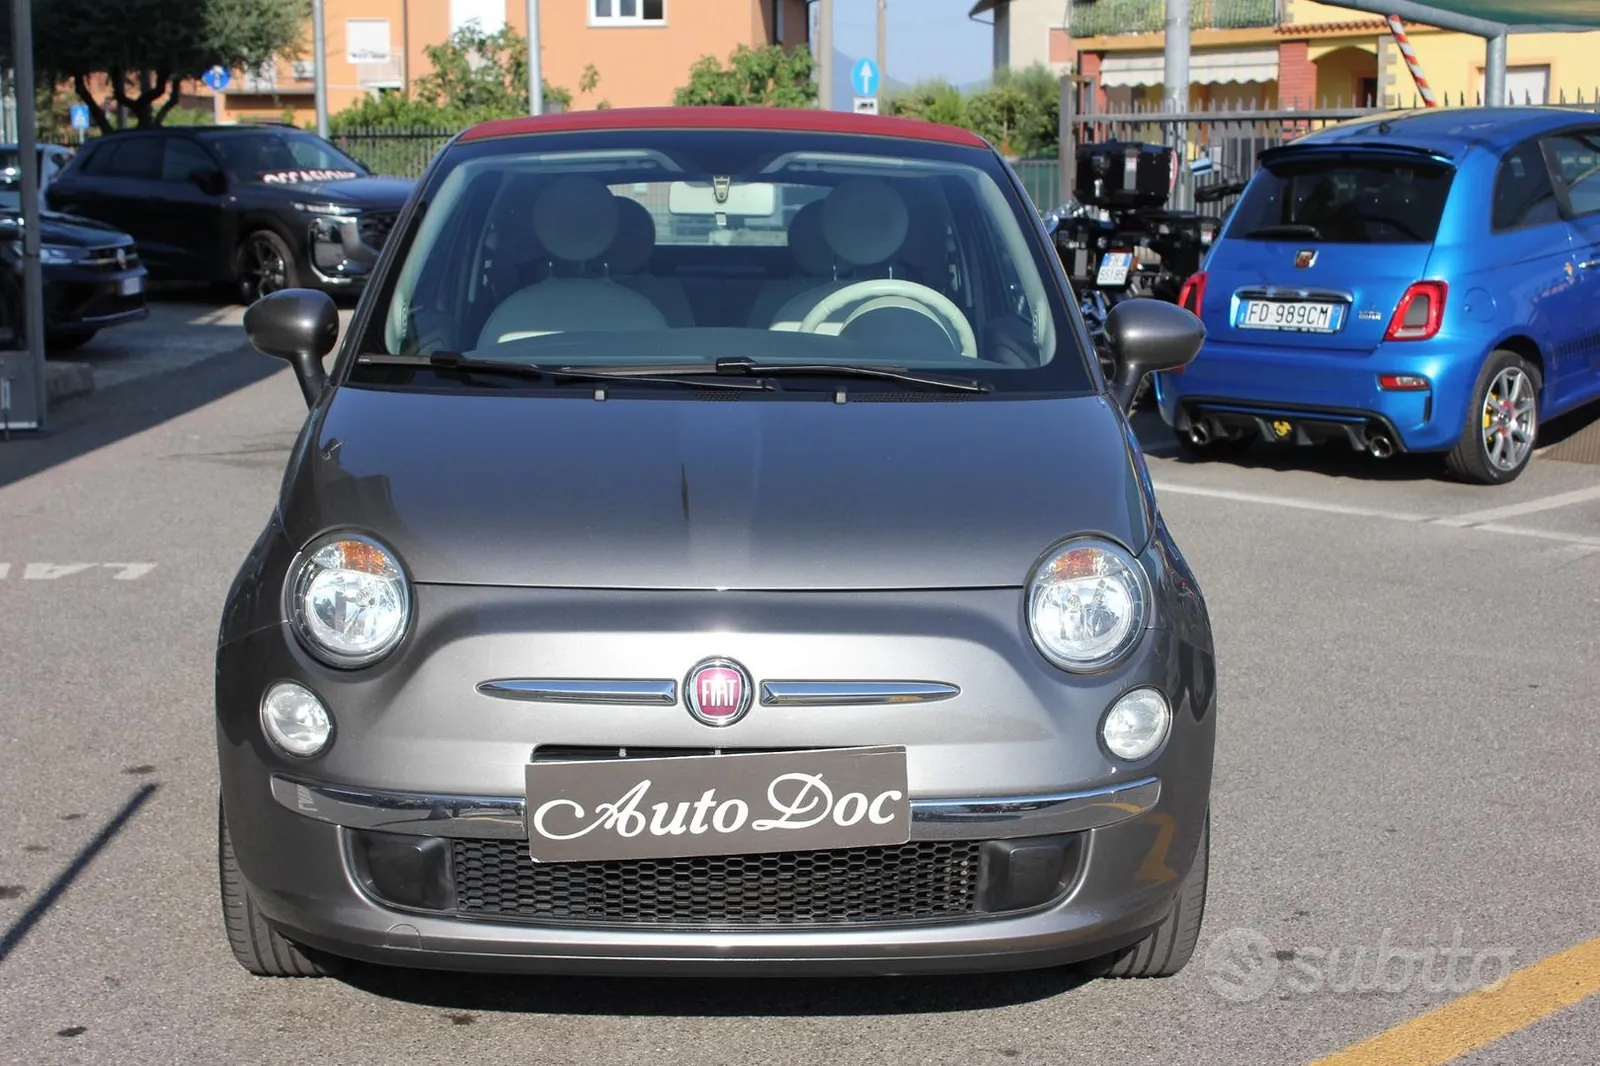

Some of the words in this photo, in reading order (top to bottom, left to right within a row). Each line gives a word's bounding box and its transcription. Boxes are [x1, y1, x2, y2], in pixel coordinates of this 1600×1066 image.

[1249, 302, 1270, 322] FD
[1275, 303, 1330, 326] 989CM
[701, 678, 737, 707] FIAT
[533, 779, 748, 840] Auto
[752, 772, 903, 831] Doc
